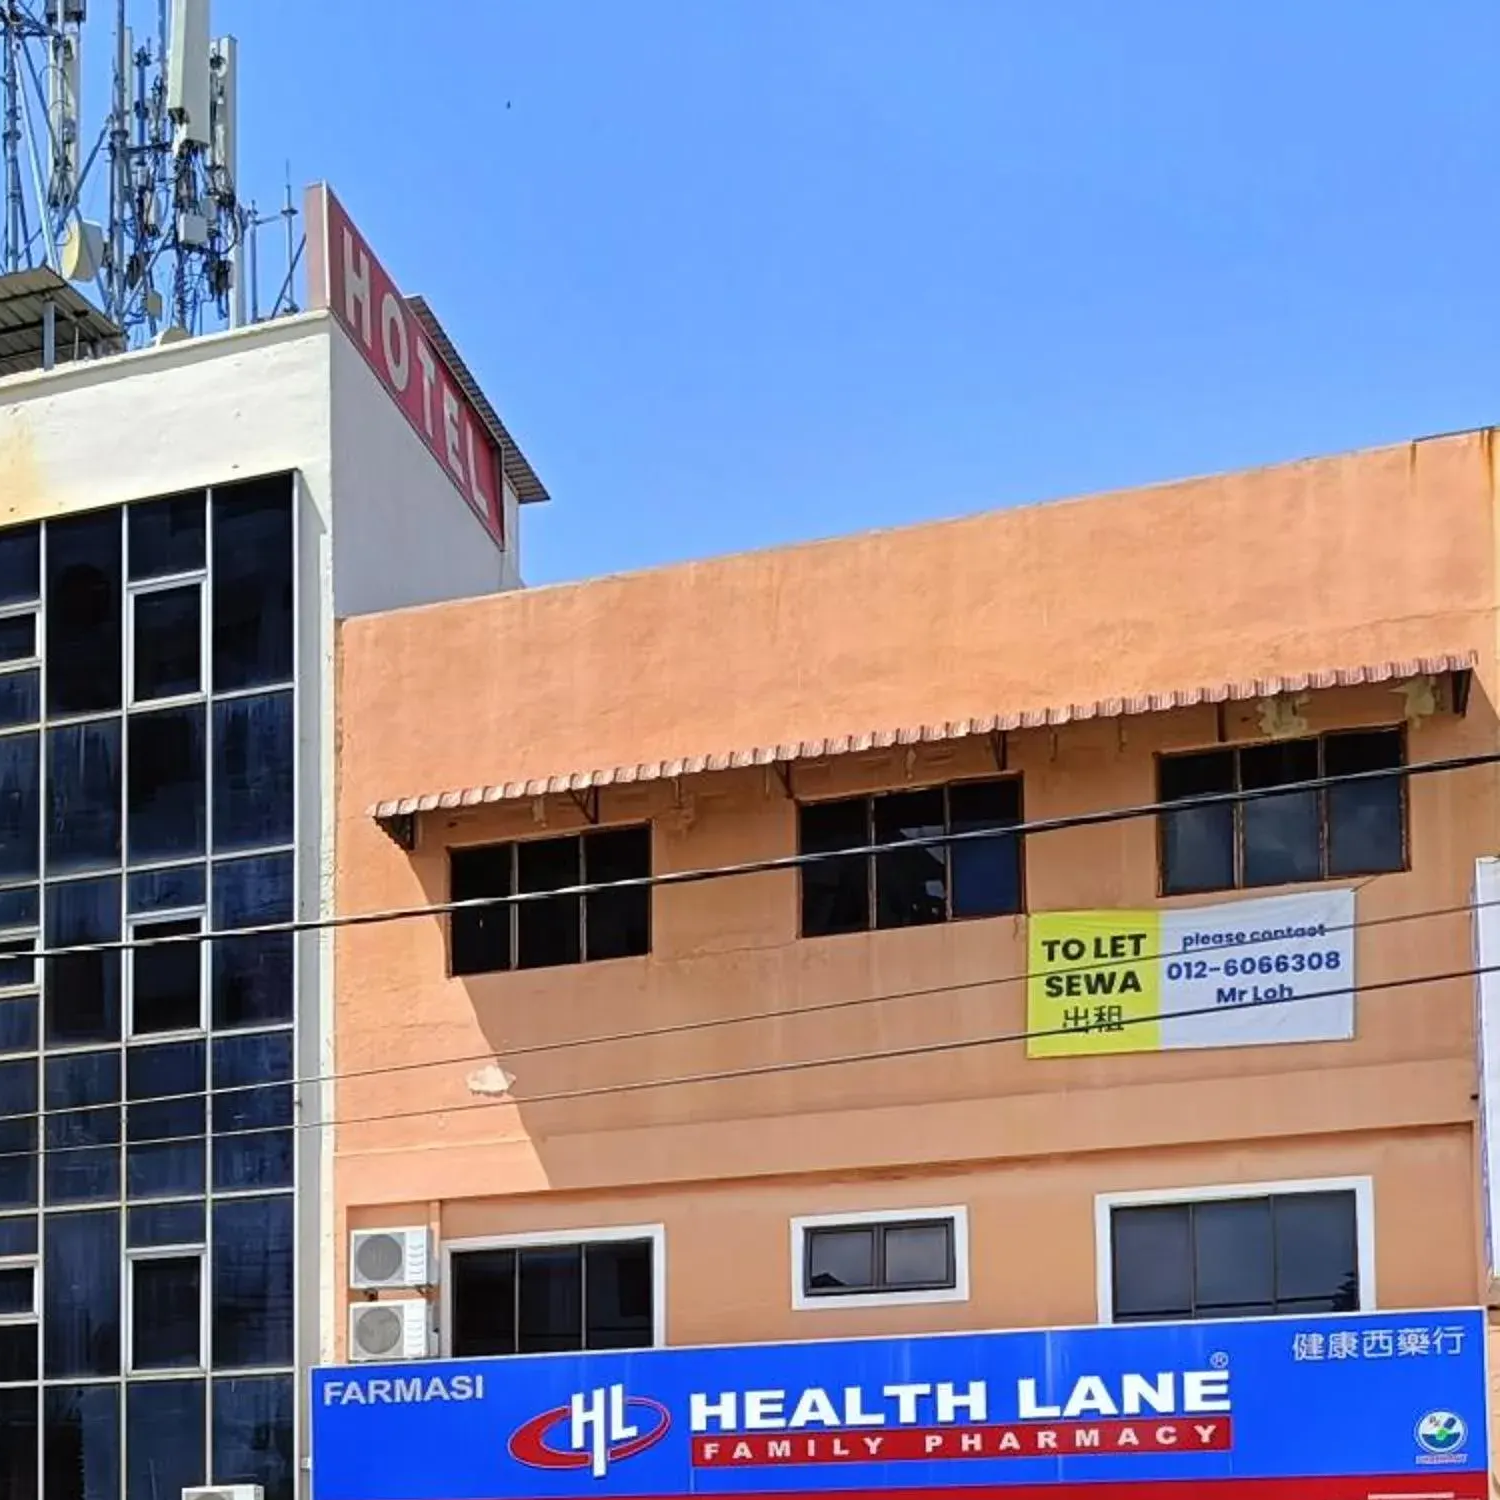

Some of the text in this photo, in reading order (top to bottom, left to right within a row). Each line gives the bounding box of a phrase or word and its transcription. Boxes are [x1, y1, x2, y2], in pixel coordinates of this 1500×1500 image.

[342, 226, 490, 524] HOTEL
[1041, 933, 1147, 962] TO LET
[1182, 923, 1326, 952] please contact
[1166, 950, 1341, 981] 012-6066308
[1045, 970, 1143, 998] SEWA
[1216, 983, 1294, 1005] Mr Loh
[1062, 1004, 1125, 1034] 出租
[1292, 1325, 1465, 1361] 健康西藥行
[323, 1374, 484, 1406] FARMASI
[689, 1369, 1232, 1432] HEALTH LANE
[570, 1383, 639, 1479] HL
[703, 1424, 1217, 1460] FAMILY PHARMACY
